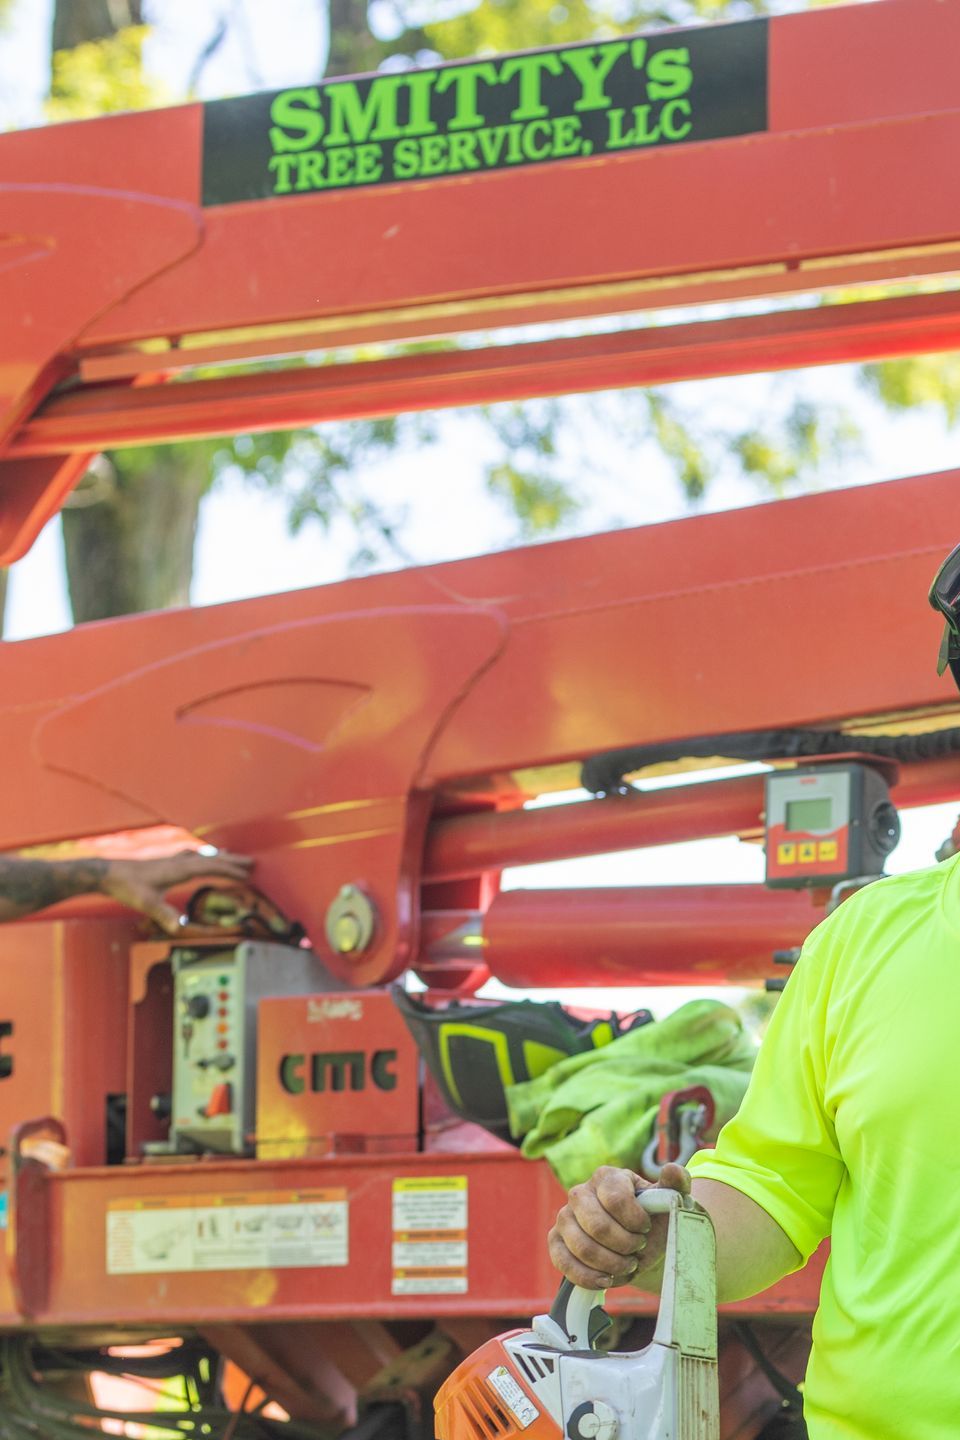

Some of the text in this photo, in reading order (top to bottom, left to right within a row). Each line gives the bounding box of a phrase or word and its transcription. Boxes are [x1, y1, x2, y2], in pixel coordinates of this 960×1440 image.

[269, 99, 693, 193] TREE SERVICE, LLC
